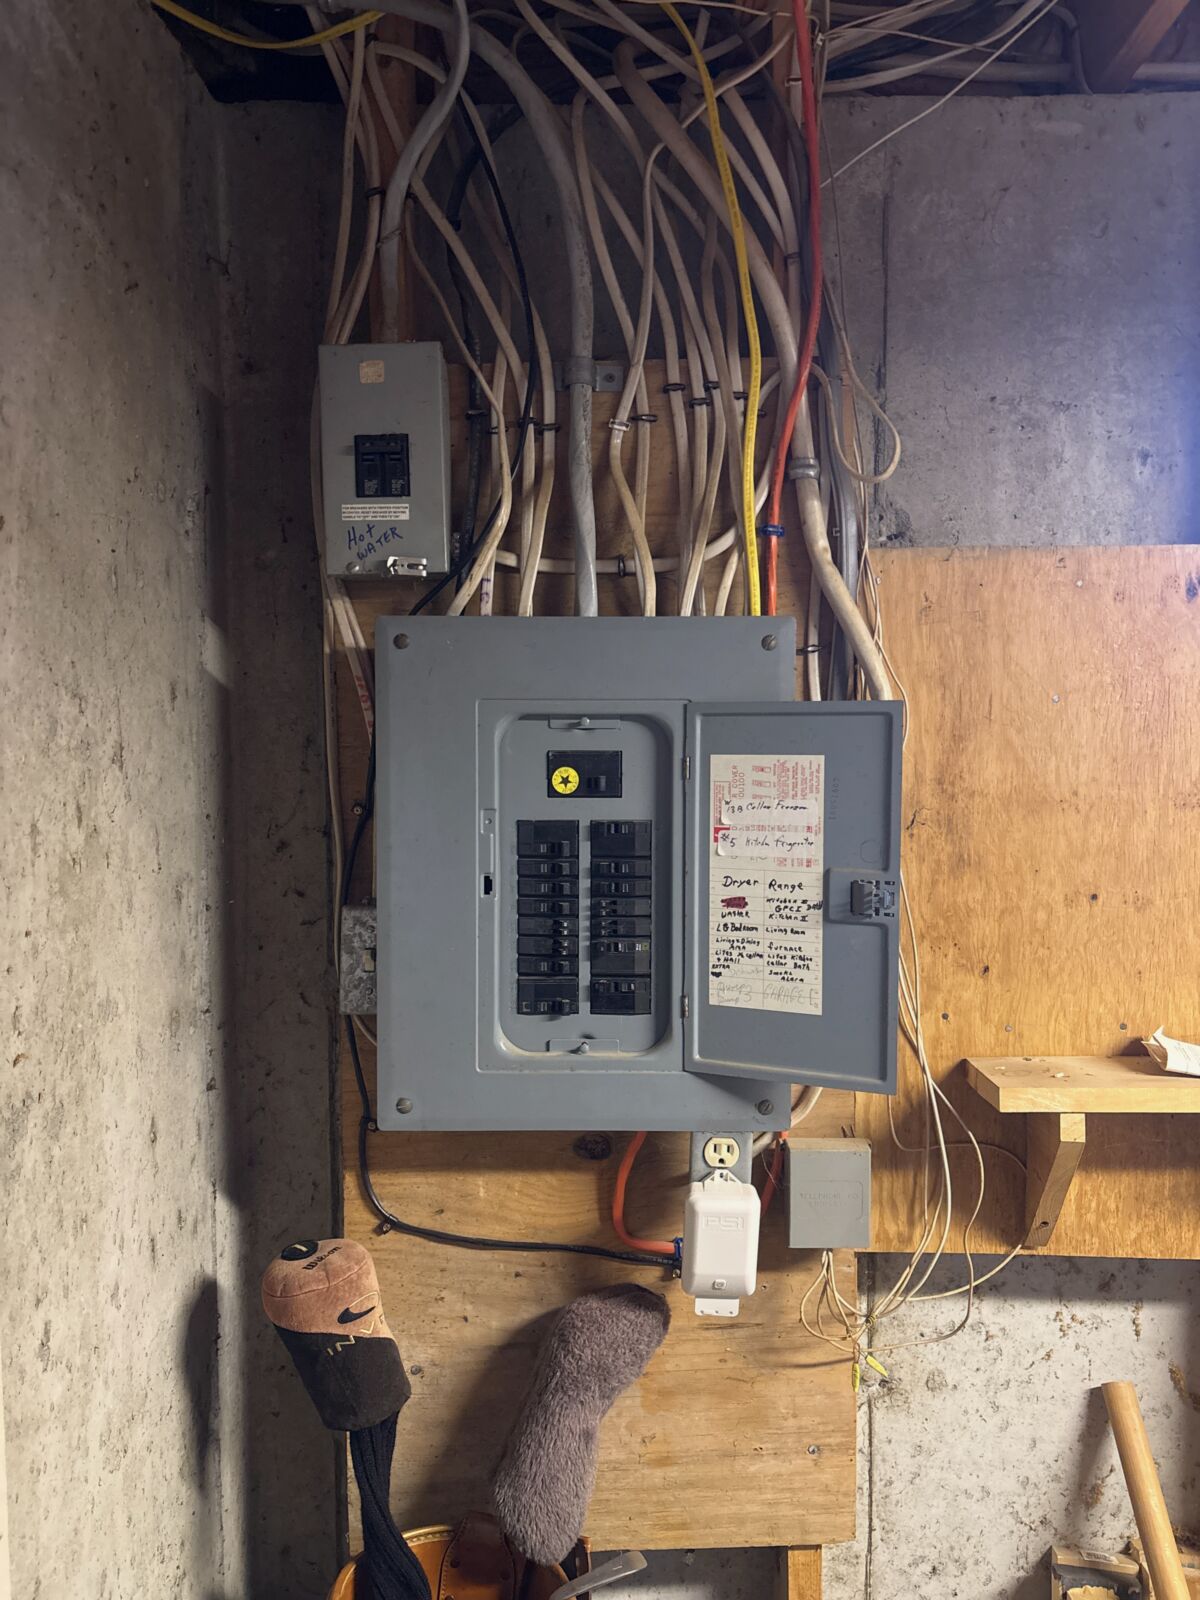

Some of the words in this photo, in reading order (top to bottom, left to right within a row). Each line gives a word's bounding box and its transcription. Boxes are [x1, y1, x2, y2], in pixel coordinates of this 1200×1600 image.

[356, 526, 404, 560] WATER
[722, 875, 759, 888] Dryer
[768, 879, 804, 893] Range
[302, 1245, 342, 1270] Wilson
